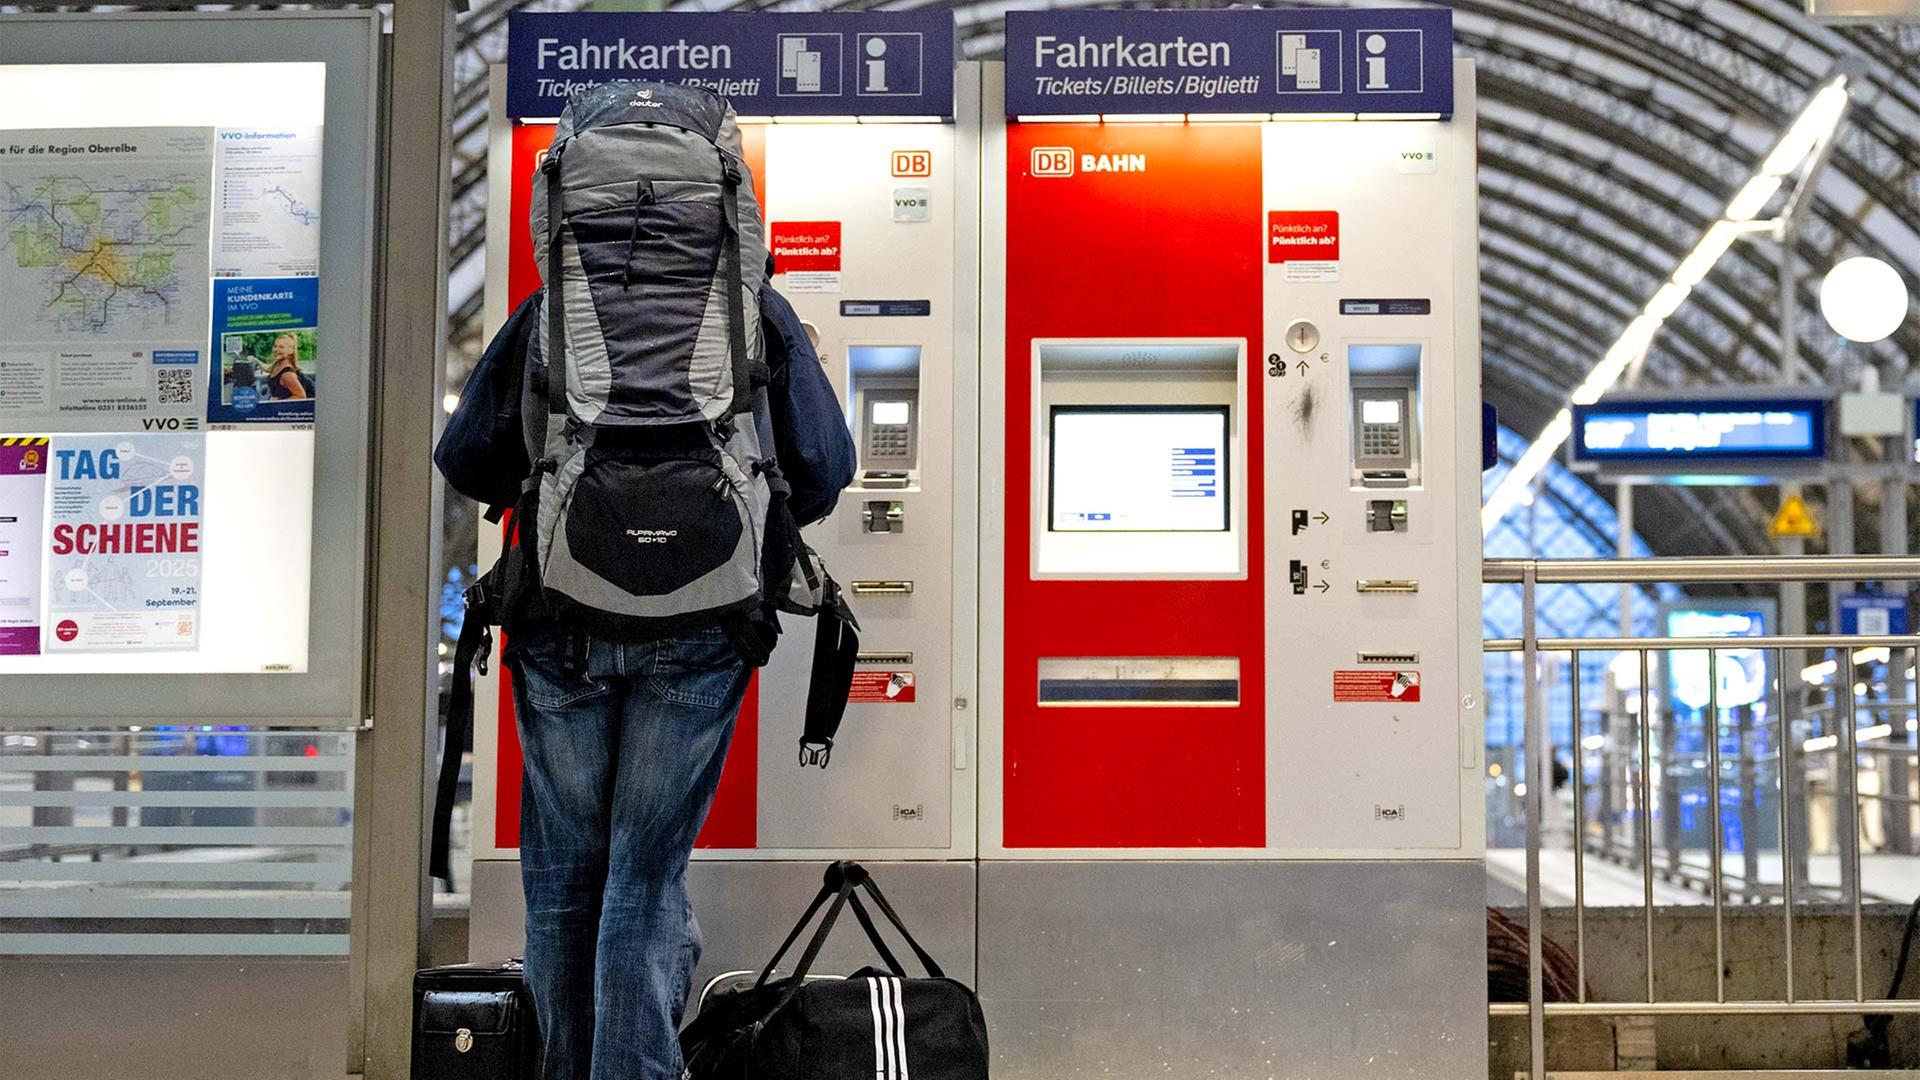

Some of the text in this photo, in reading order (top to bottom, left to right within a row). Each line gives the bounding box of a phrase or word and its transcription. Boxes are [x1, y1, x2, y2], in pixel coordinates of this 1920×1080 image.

[537, 38, 731, 70] Fahrkarten
[1036, 35, 1230, 68] Fahrkarten
[629, 100, 664, 108] deuter
[9, 145, 25, 154] für
[28, 145, 45, 154] die
[48, 145, 85, 156] Region
[88, 143, 137, 154] Oberelbe
[1401, 152, 1423, 160] VVO
[897, 155, 926, 173] DB
[1038, 153, 1146, 172] DB BAHN
[895, 199, 917, 207] VVO
[1272, 224, 1328, 233] Pünktlich an?
[775, 235, 830, 244] Pünktlich an?
[1272, 236, 1336, 245] Pünktlich ab?
[775, 247, 838, 256] Pünktlich ab?
[227, 286, 253, 294] MEINE
[227, 292, 294, 303] KUNDENKARTE
[240, 303, 258, 311] VVO
[142, 418, 179, 430] VVO
[56, 449, 119, 480] TAG
[130, 485, 199, 517] DER
[52, 523, 199, 555] SCHIENE
[146, 558, 199, 578] 2025
[146, 599, 196, 608] September
